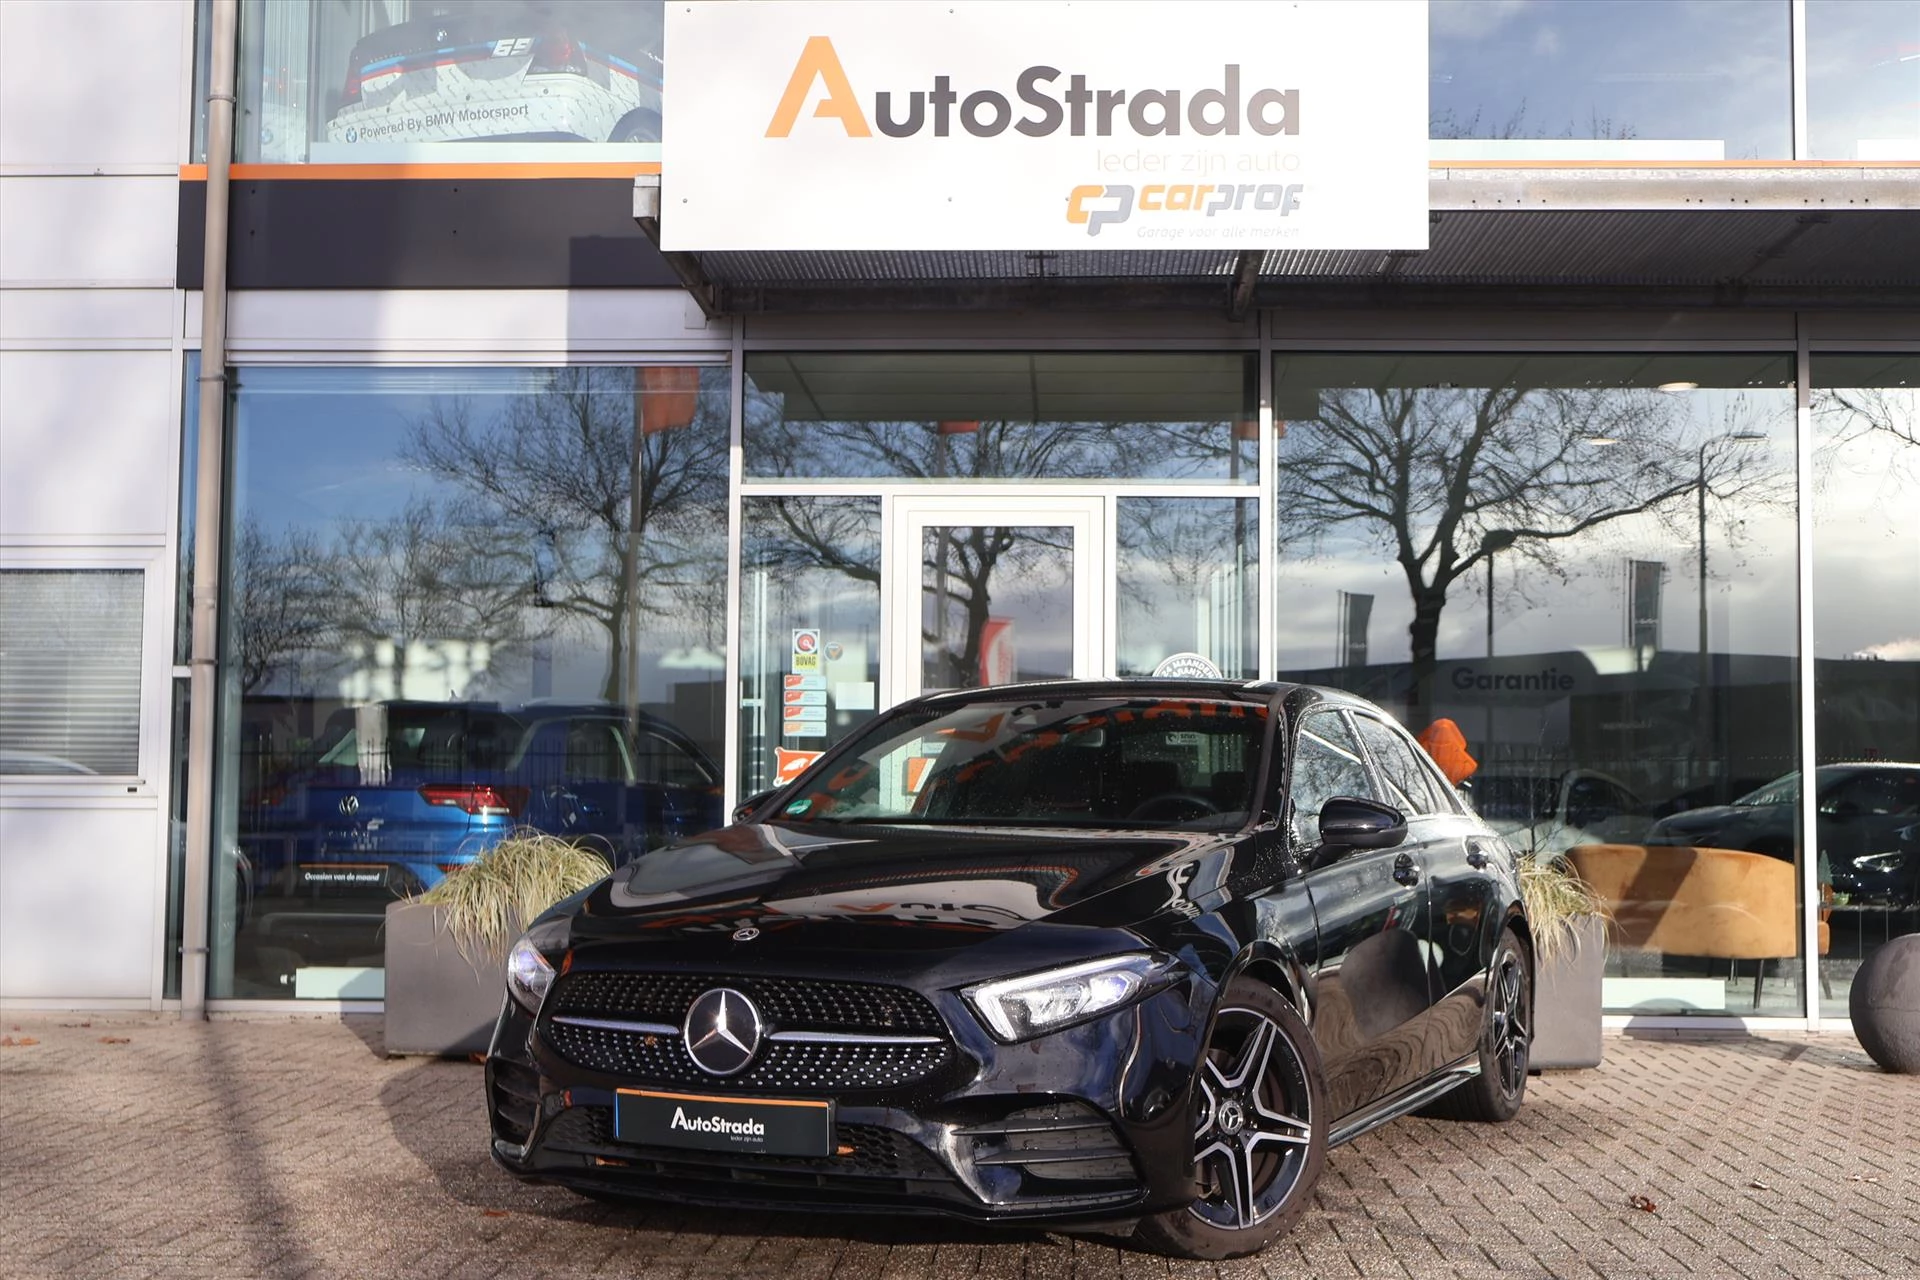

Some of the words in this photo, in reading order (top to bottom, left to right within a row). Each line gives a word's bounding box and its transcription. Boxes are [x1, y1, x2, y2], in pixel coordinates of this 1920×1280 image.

[491, 37, 534, 57] 69
[764, 36, 1300, 138] AutoStrada
[360, 121, 404, 139] Powered
[407, 118, 422, 132] By
[425, 111, 455, 127] BMW
[458, 103, 529, 122] Motorsport
[1097, 149, 1172, 172] Ieder
[1181, 150, 1227, 177] zijn
[1237, 151, 1301, 172] auto
[1138, 184, 1304, 217] carprof
[1137, 225, 1184, 240] Garage
[1189, 228, 1218, 238] voor
[1221, 225, 1247, 238] alle
[1250, 225, 1300, 238] merken
[795, 656, 817, 666] BOVAG
[1172, 658, 1215, 678] MAANDEN
[1451, 666, 1576, 690] Garantie
[346, 872, 356, 881] de
[356, 872, 380, 881] maand
[671, 1106, 765, 1135] AutoStrada
